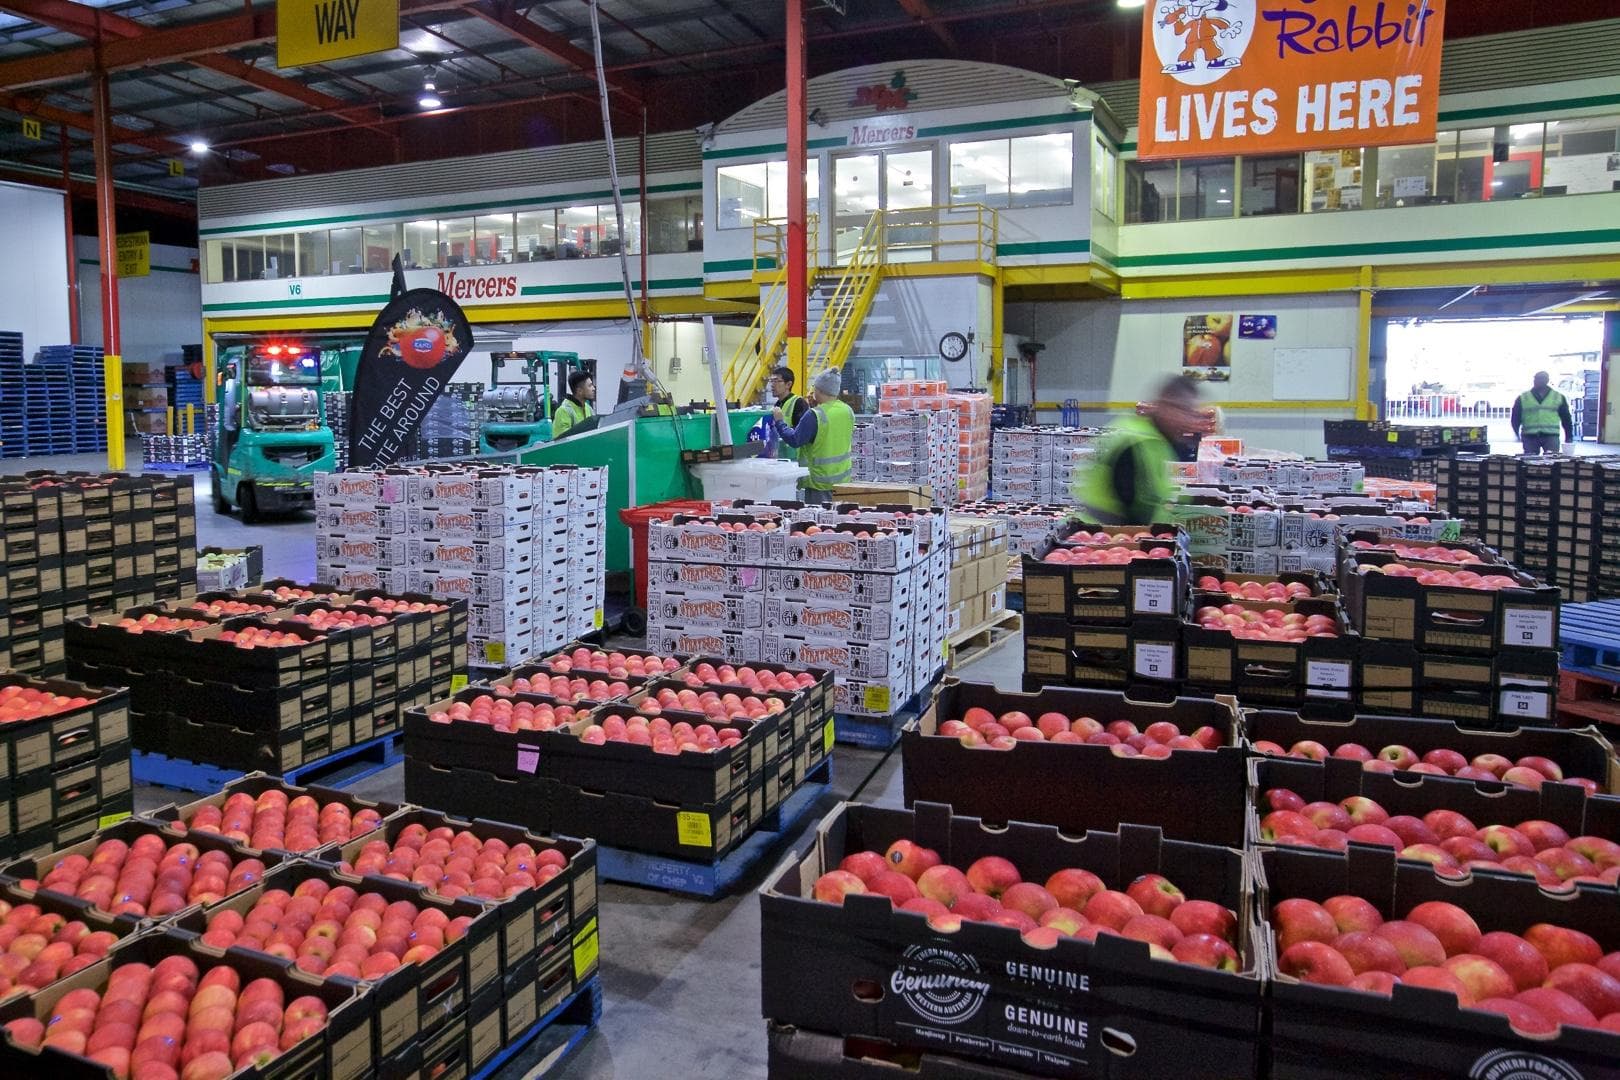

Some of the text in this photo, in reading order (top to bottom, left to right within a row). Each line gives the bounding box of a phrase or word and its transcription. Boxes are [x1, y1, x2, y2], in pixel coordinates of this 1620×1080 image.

[315, 0, 360, 45] WAY
[1262, 3, 1434, 59] Rabbit
[1155, 74, 1422, 142] LIVES HERE
[26, 123, 38, 138] N
[851, 125, 914, 145] Mercers
[172, 161, 181, 175] L
[117, 235, 148, 248] EDESTRIAN
[125, 263, 138, 275] EXIT
[289, 284, 301, 296] V6
[437, 271, 517, 299] Mercers
[358, 418, 384, 450] THE
[380, 377, 413, 419] BEST
[370, 439, 399, 472] BITE
[393, 376, 440, 442] AROUND
[1006, 960, 1089, 992] GENUINE
[1005, 1004, 1088, 1038] GENUINE
[1007, 1022, 1086, 1049] down-to-earth locals
